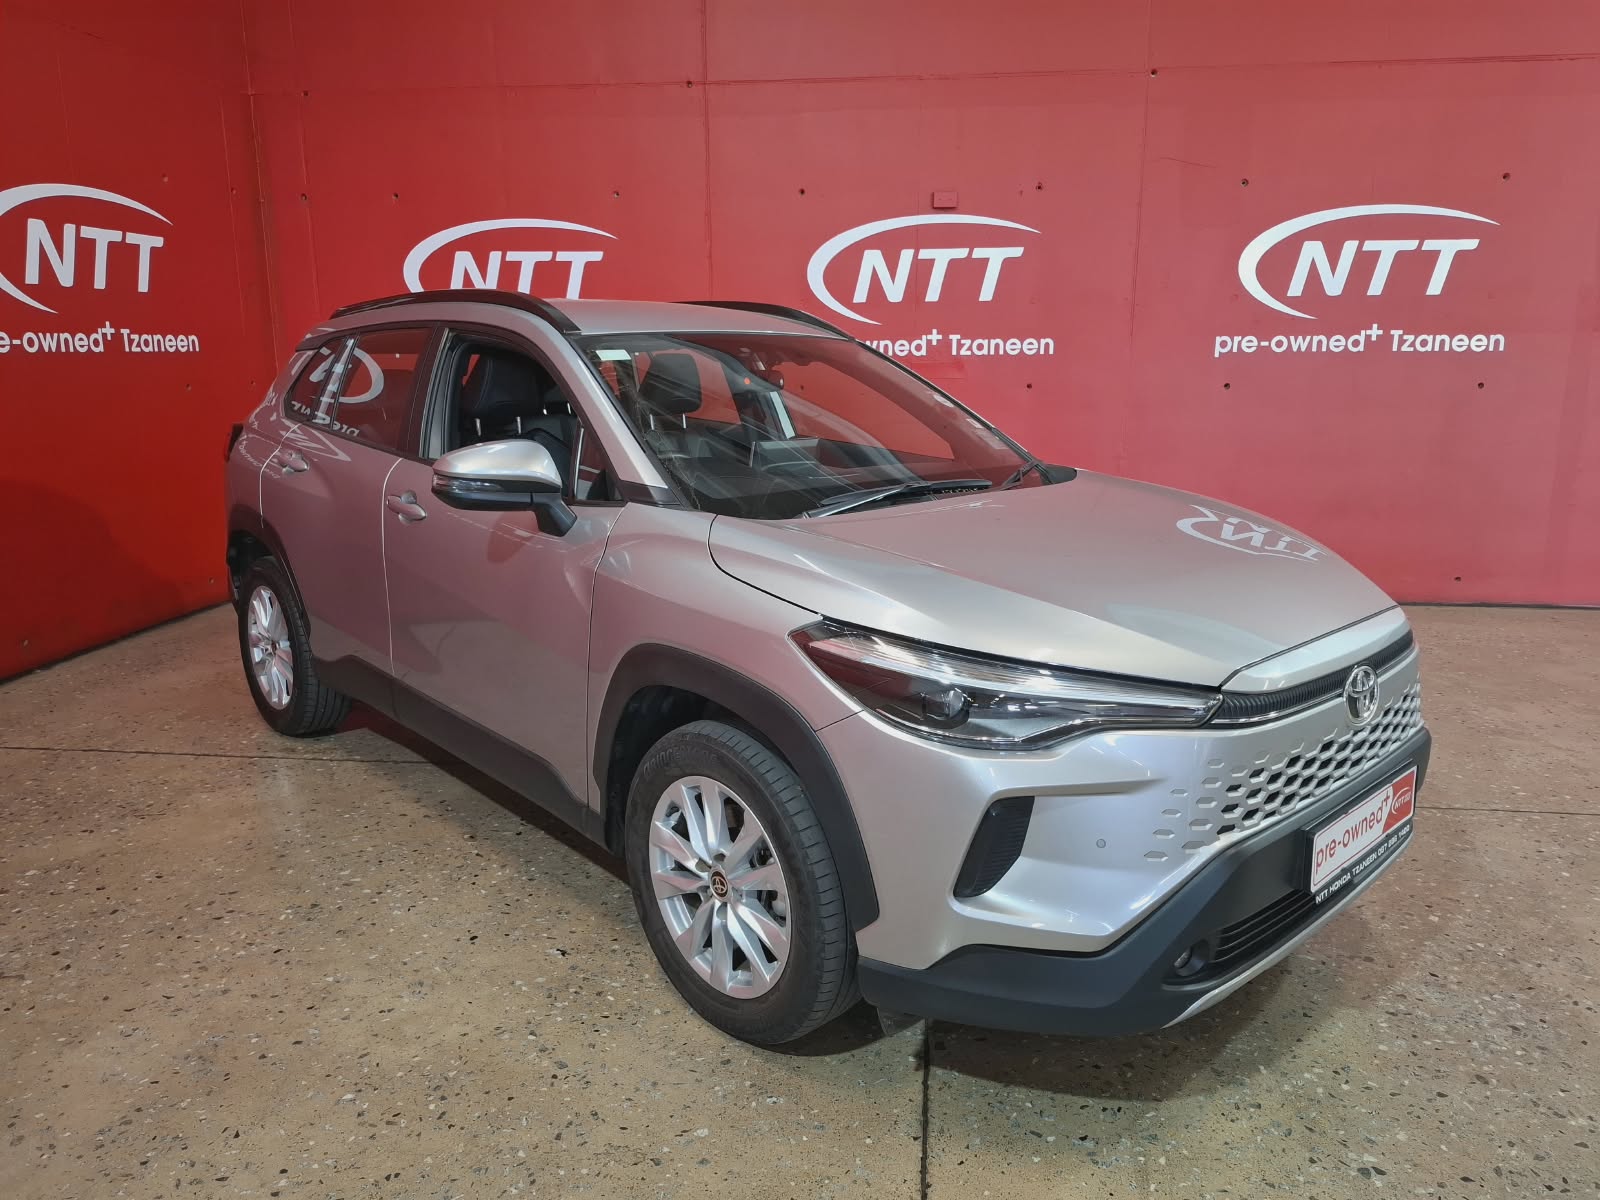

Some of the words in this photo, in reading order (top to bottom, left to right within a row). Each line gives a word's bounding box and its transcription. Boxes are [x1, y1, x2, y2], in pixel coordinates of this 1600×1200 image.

[25, 218, 164, 292] NTT
[450, 250, 604, 300] NTT
[853, 247, 1024, 303] NTT
[1287, 239, 1480, 297] NTT
[120, 328, 200, 352] Tzaneen
[949, 334, 1055, 356] Tzaneen
[1390, 330, 1505, 352] Tzaneen
[1315, 889, 1329, 904] NTT
[1329, 872, 1351, 893] HONDA
[1352, 852, 1377, 876] TZANEEN
